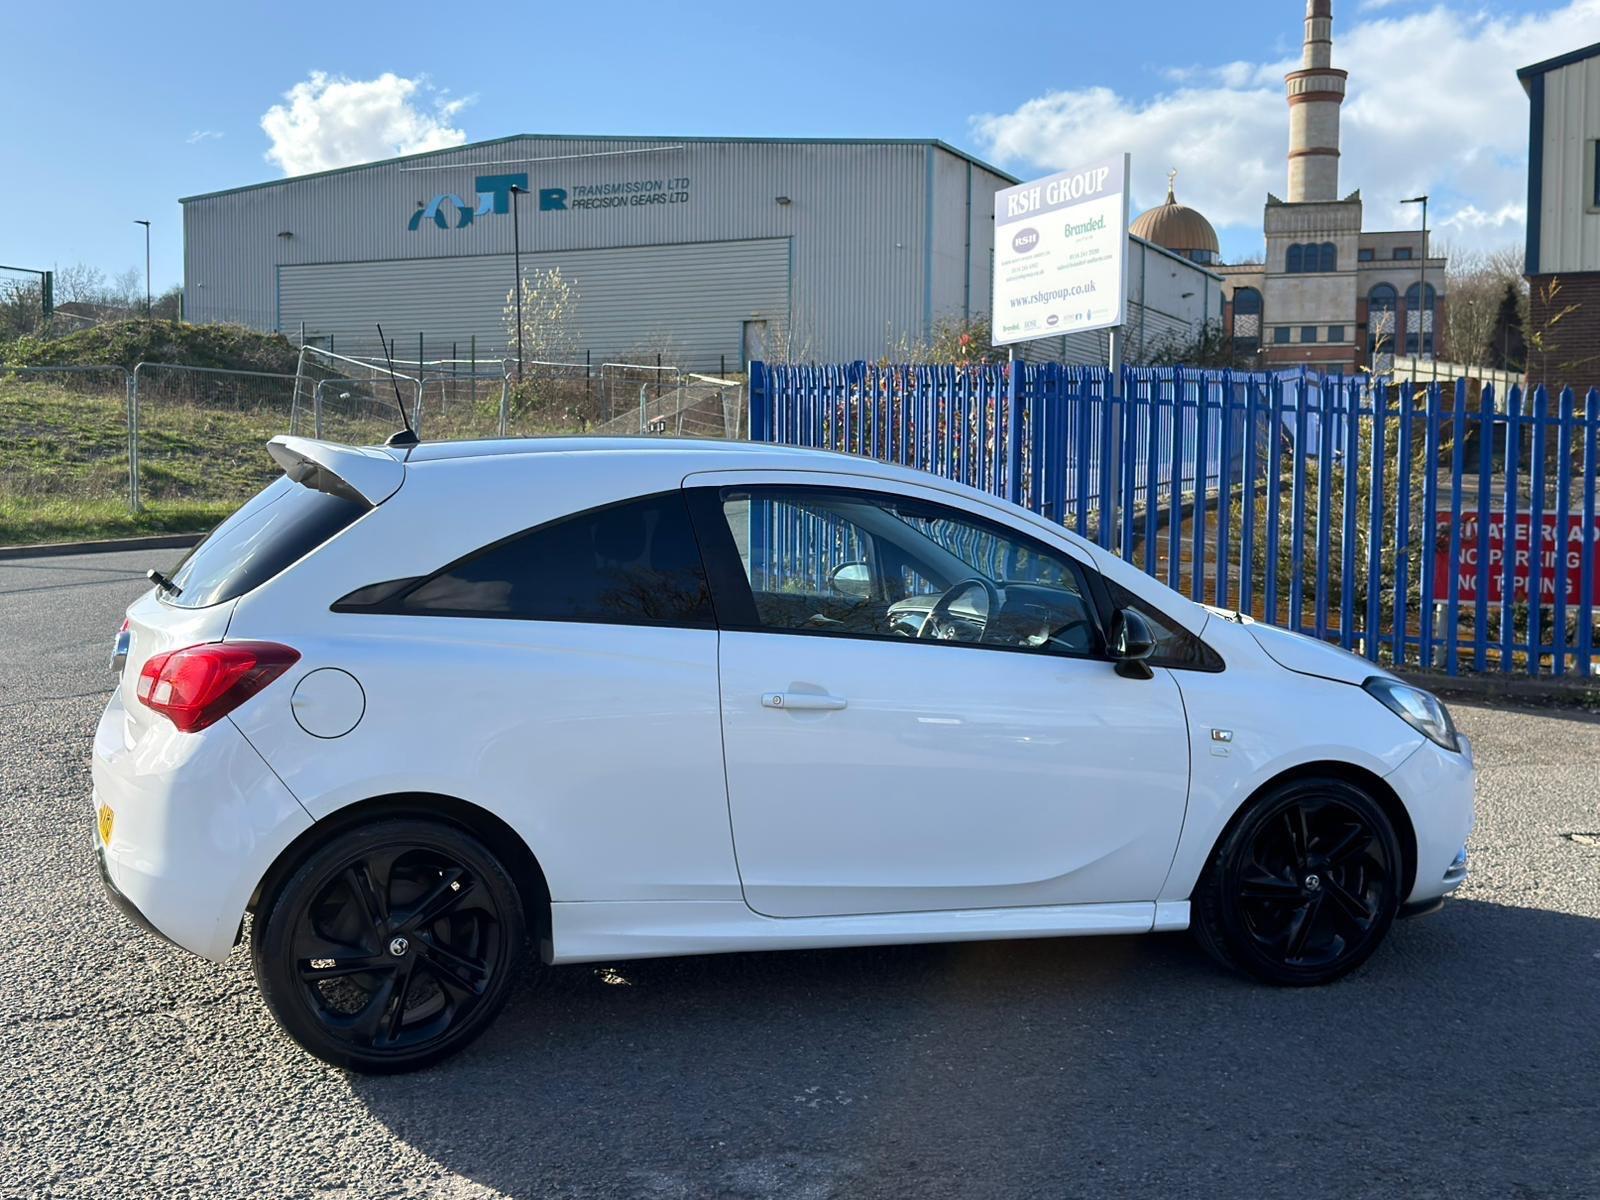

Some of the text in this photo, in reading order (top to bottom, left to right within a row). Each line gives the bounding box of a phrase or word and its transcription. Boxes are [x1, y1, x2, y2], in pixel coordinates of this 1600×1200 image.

[572, 177, 690, 197] TRANSMISSION LTD
[1006, 166, 1109, 218] RSH GROUP
[572, 191, 689, 210] PRECISION GEARS LTD
[1009, 279, 1097, 309] www.rshgroup.co.uk
[1489, 549, 1580, 568] PRIG
[1492, 575, 1574, 594] TPING
